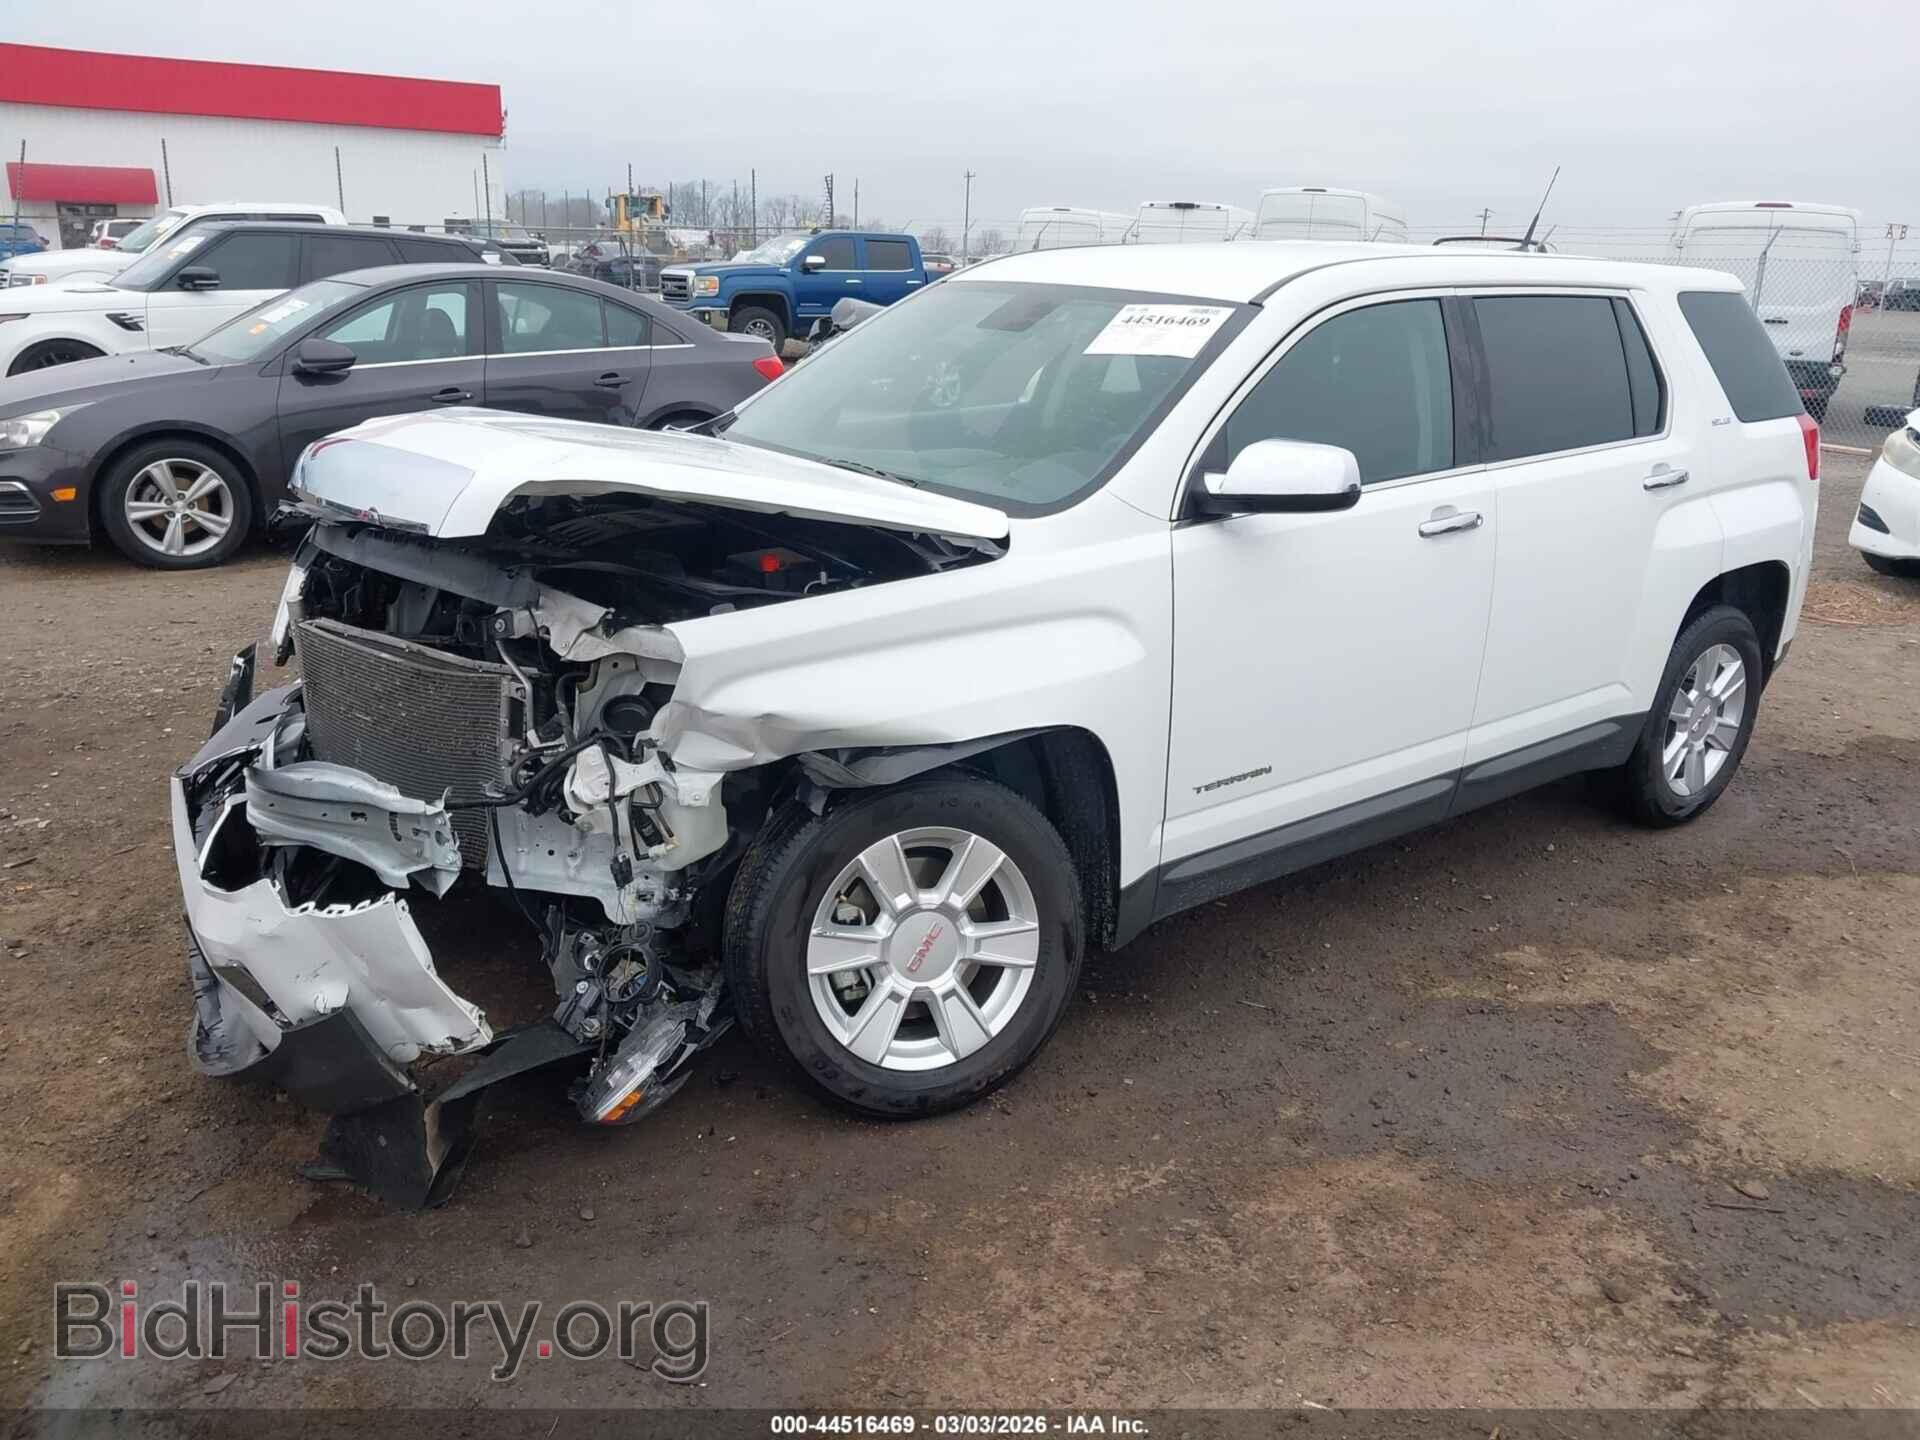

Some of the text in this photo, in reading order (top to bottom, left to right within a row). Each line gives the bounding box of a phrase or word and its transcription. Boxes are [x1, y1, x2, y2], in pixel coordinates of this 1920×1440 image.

[1121, 314, 1211, 327] 44516469
[1192, 765, 1273, 794] TERRAIN
[906, 921, 943, 973] GMC
